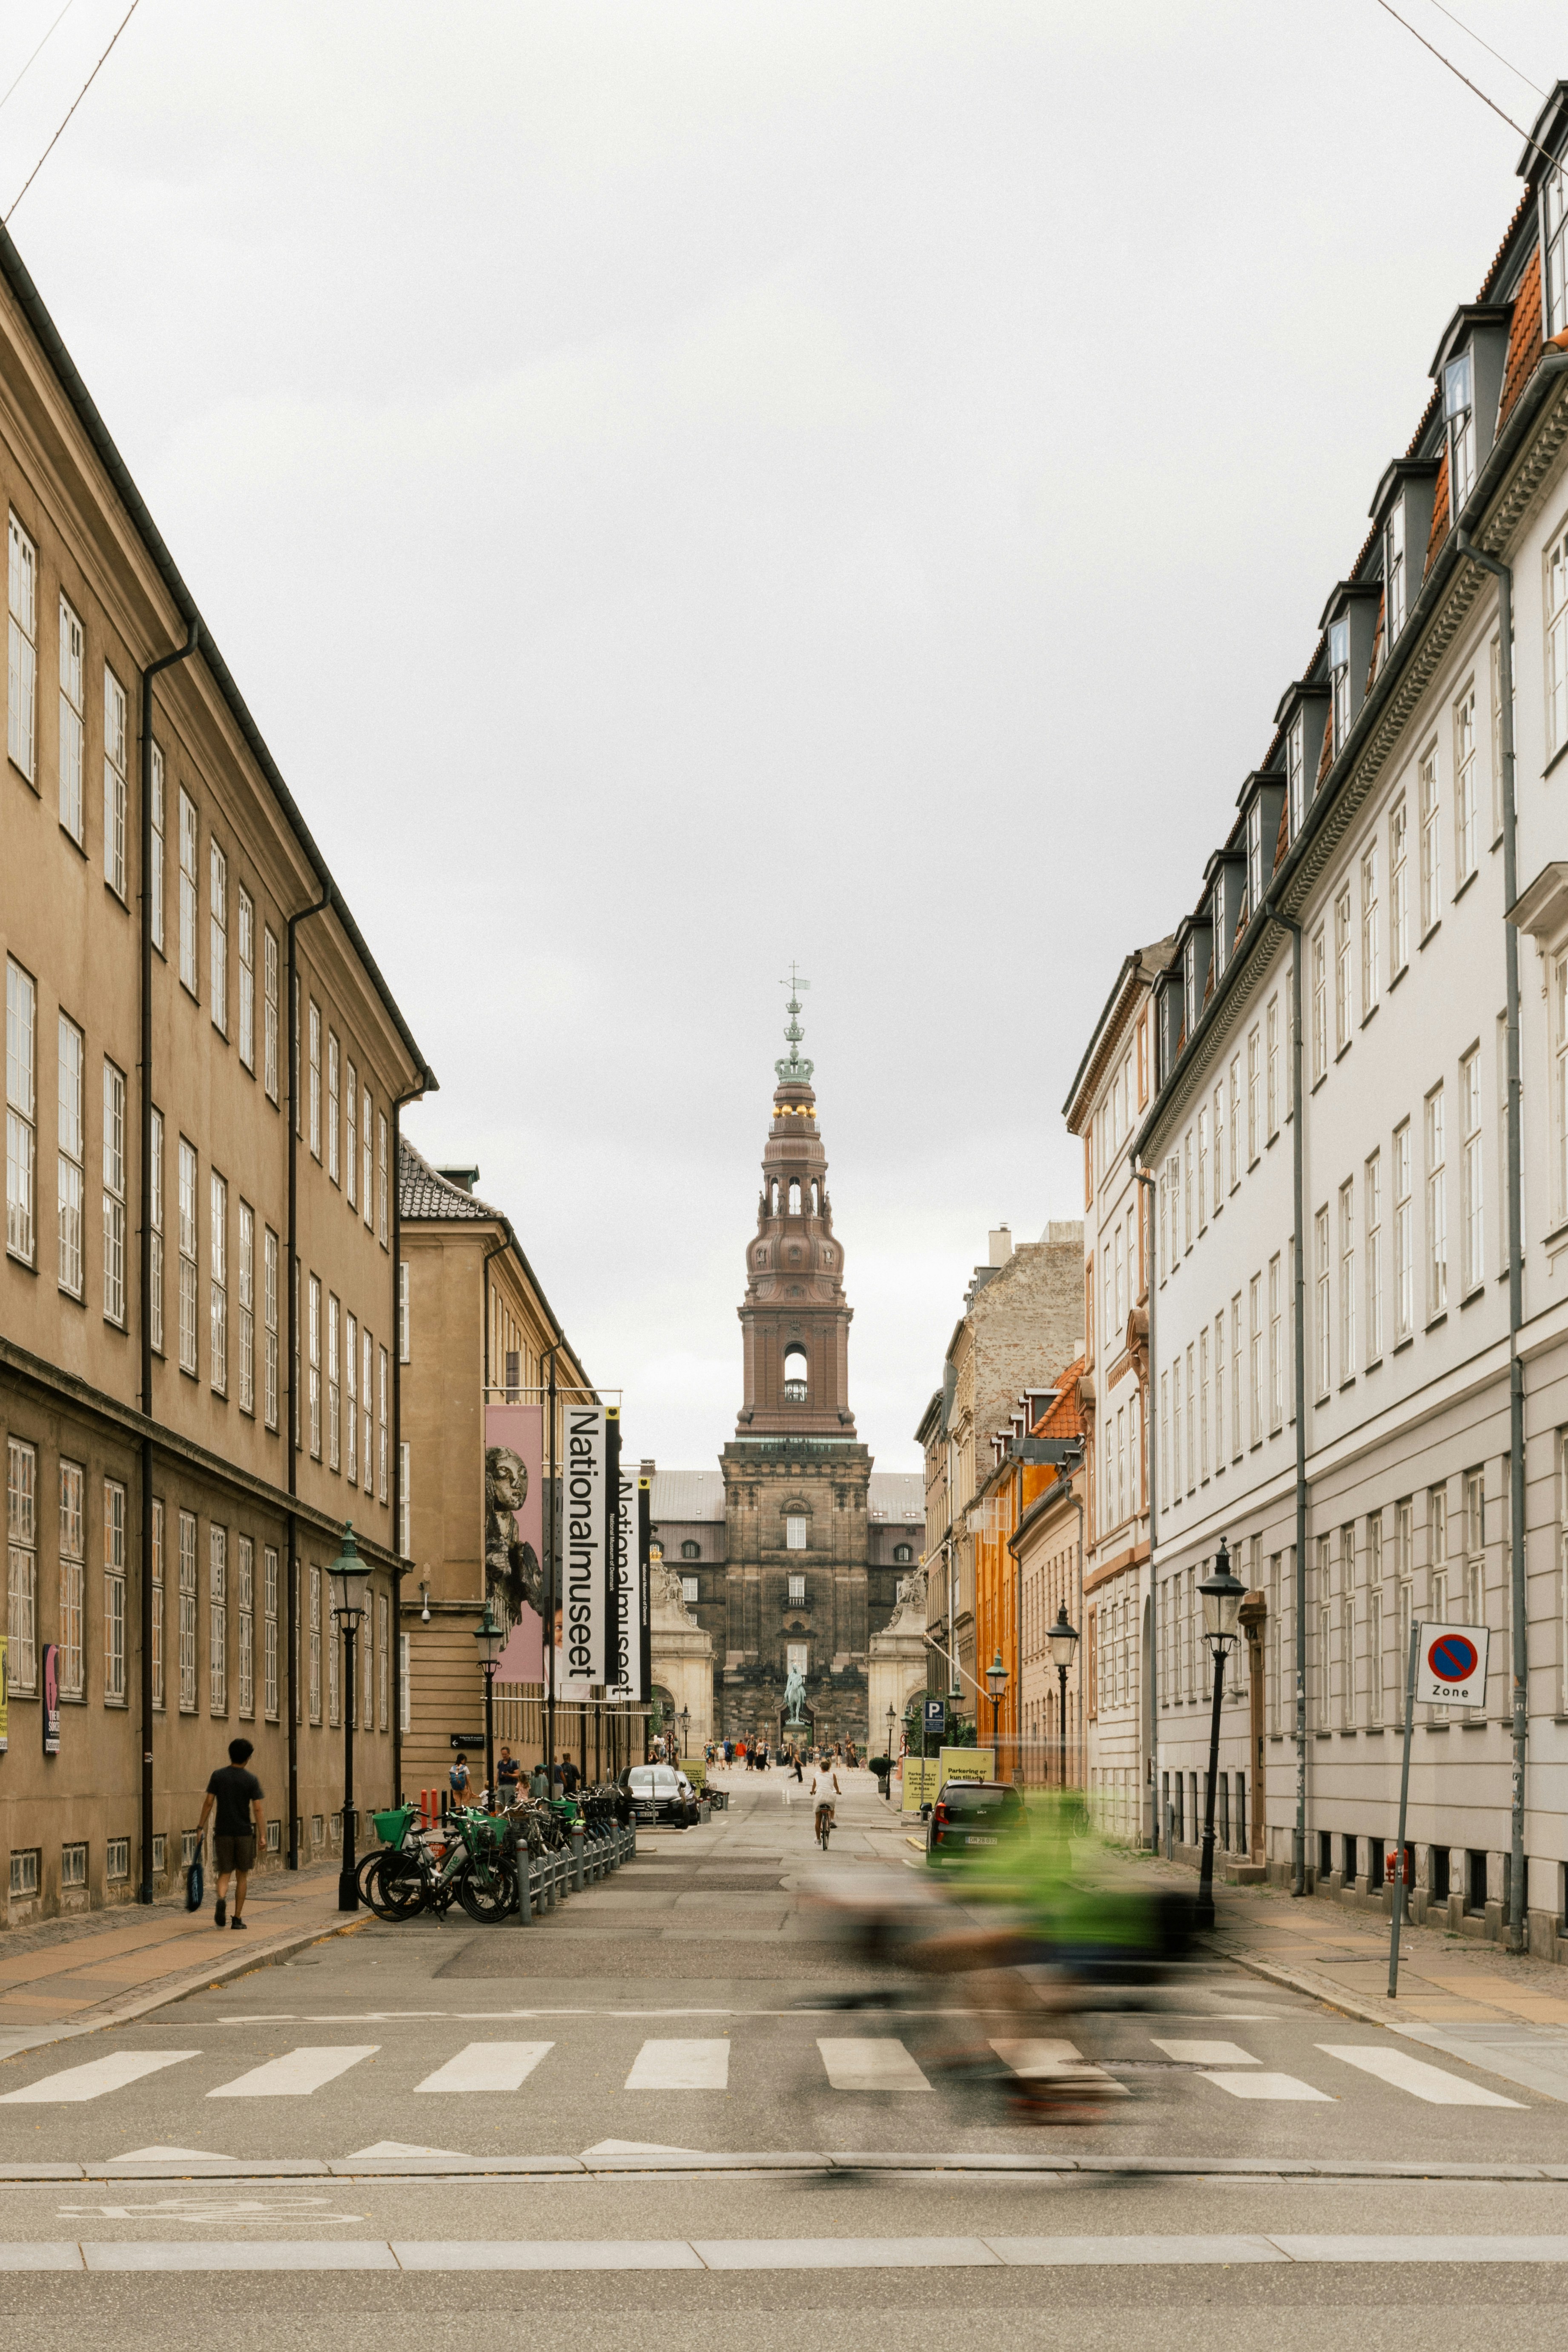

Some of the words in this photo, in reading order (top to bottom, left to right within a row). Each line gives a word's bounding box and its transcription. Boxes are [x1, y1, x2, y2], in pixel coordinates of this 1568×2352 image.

[569, 1412, 599, 1678] Nationalmuseet
[1432, 1685, 1468, 1697] Zone
[929, 1703, 940, 1718] P
